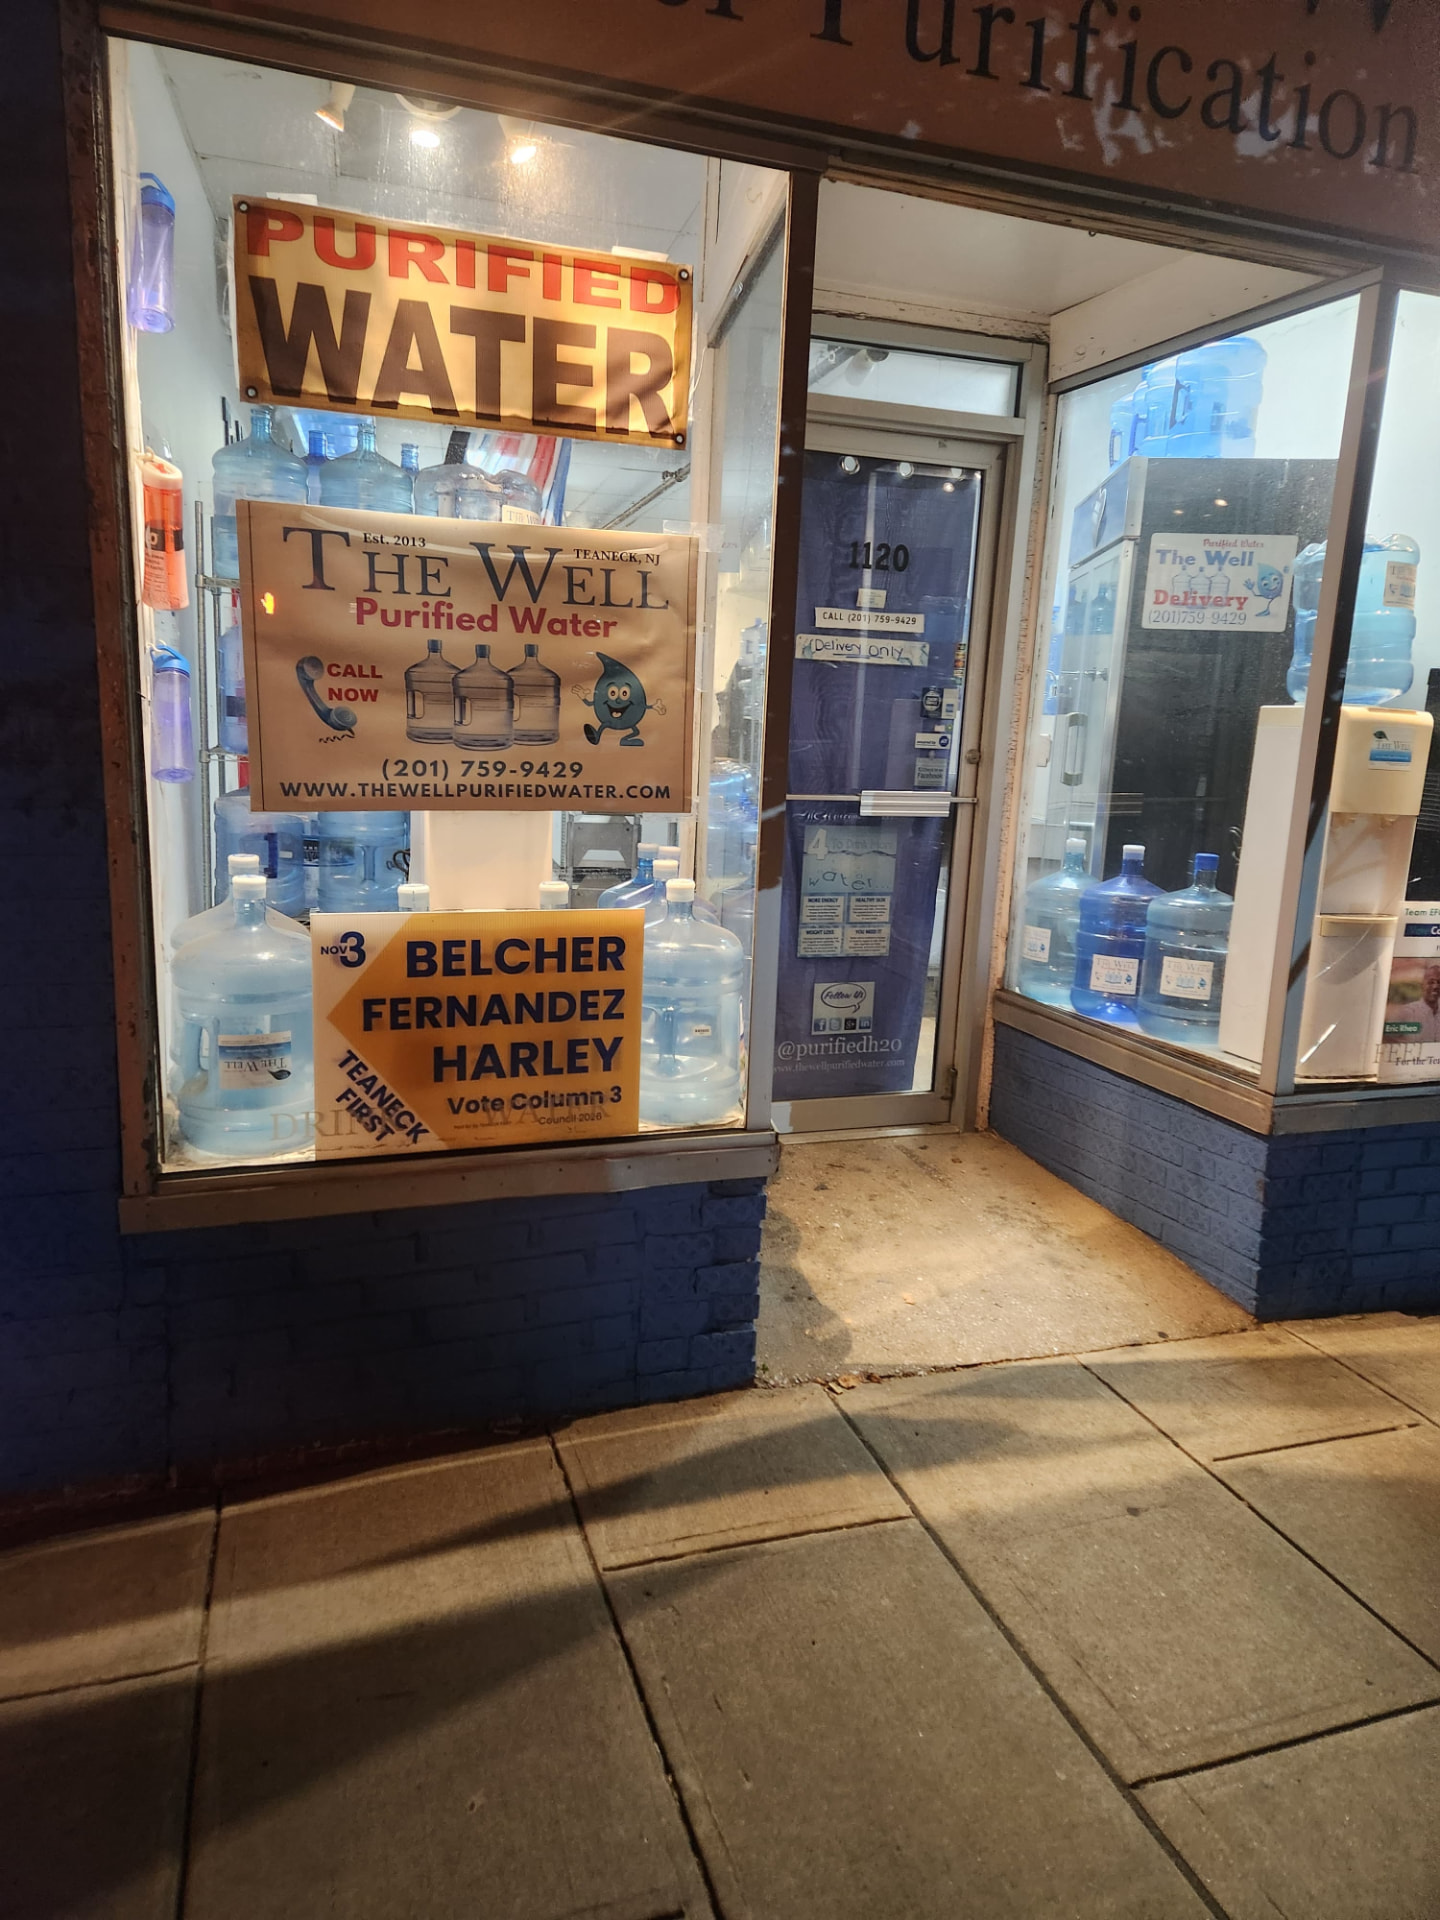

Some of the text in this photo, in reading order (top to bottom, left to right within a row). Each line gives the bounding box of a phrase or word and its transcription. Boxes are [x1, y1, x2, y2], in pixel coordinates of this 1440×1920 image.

[246, 207, 682, 315] PURIFIED
[248, 275, 676, 439] WATER
[363, 532, 427, 548] Est. 2013
[574, 548, 661, 567] TEANECK, NJ
[849, 540, 910, 573] 1120
[1155, 549, 1254, 567] The Well
[1153, 589, 1248, 611] Delivery
[356, 596, 618, 638] Purified Water
[822, 611, 917, 625] CALL (201) 759-9429
[326, 663, 383, 679] CALL
[327, 687, 380, 703] NOW
[381, 758, 585, 782] (201) 759-9429
[280, 781, 671, 800] WWW.THEWELLPURIFIEDWATER.COM
[808, 828, 828, 861] 4
[1405, 908, 1427, 916] Team
[320, 931, 366, 968] NOV 3
[407, 936, 626, 978] BELCHER
[362, 988, 625, 1031] FERNANDEZ
[433, 1036, 624, 1082] HARLEY
[338, 1049, 430, 1145] TEANECK
[447, 1085, 622, 1115] Vote Column 3
[335, 1087, 396, 1142] FIRST
[538, 1114, 577, 1125] Council
